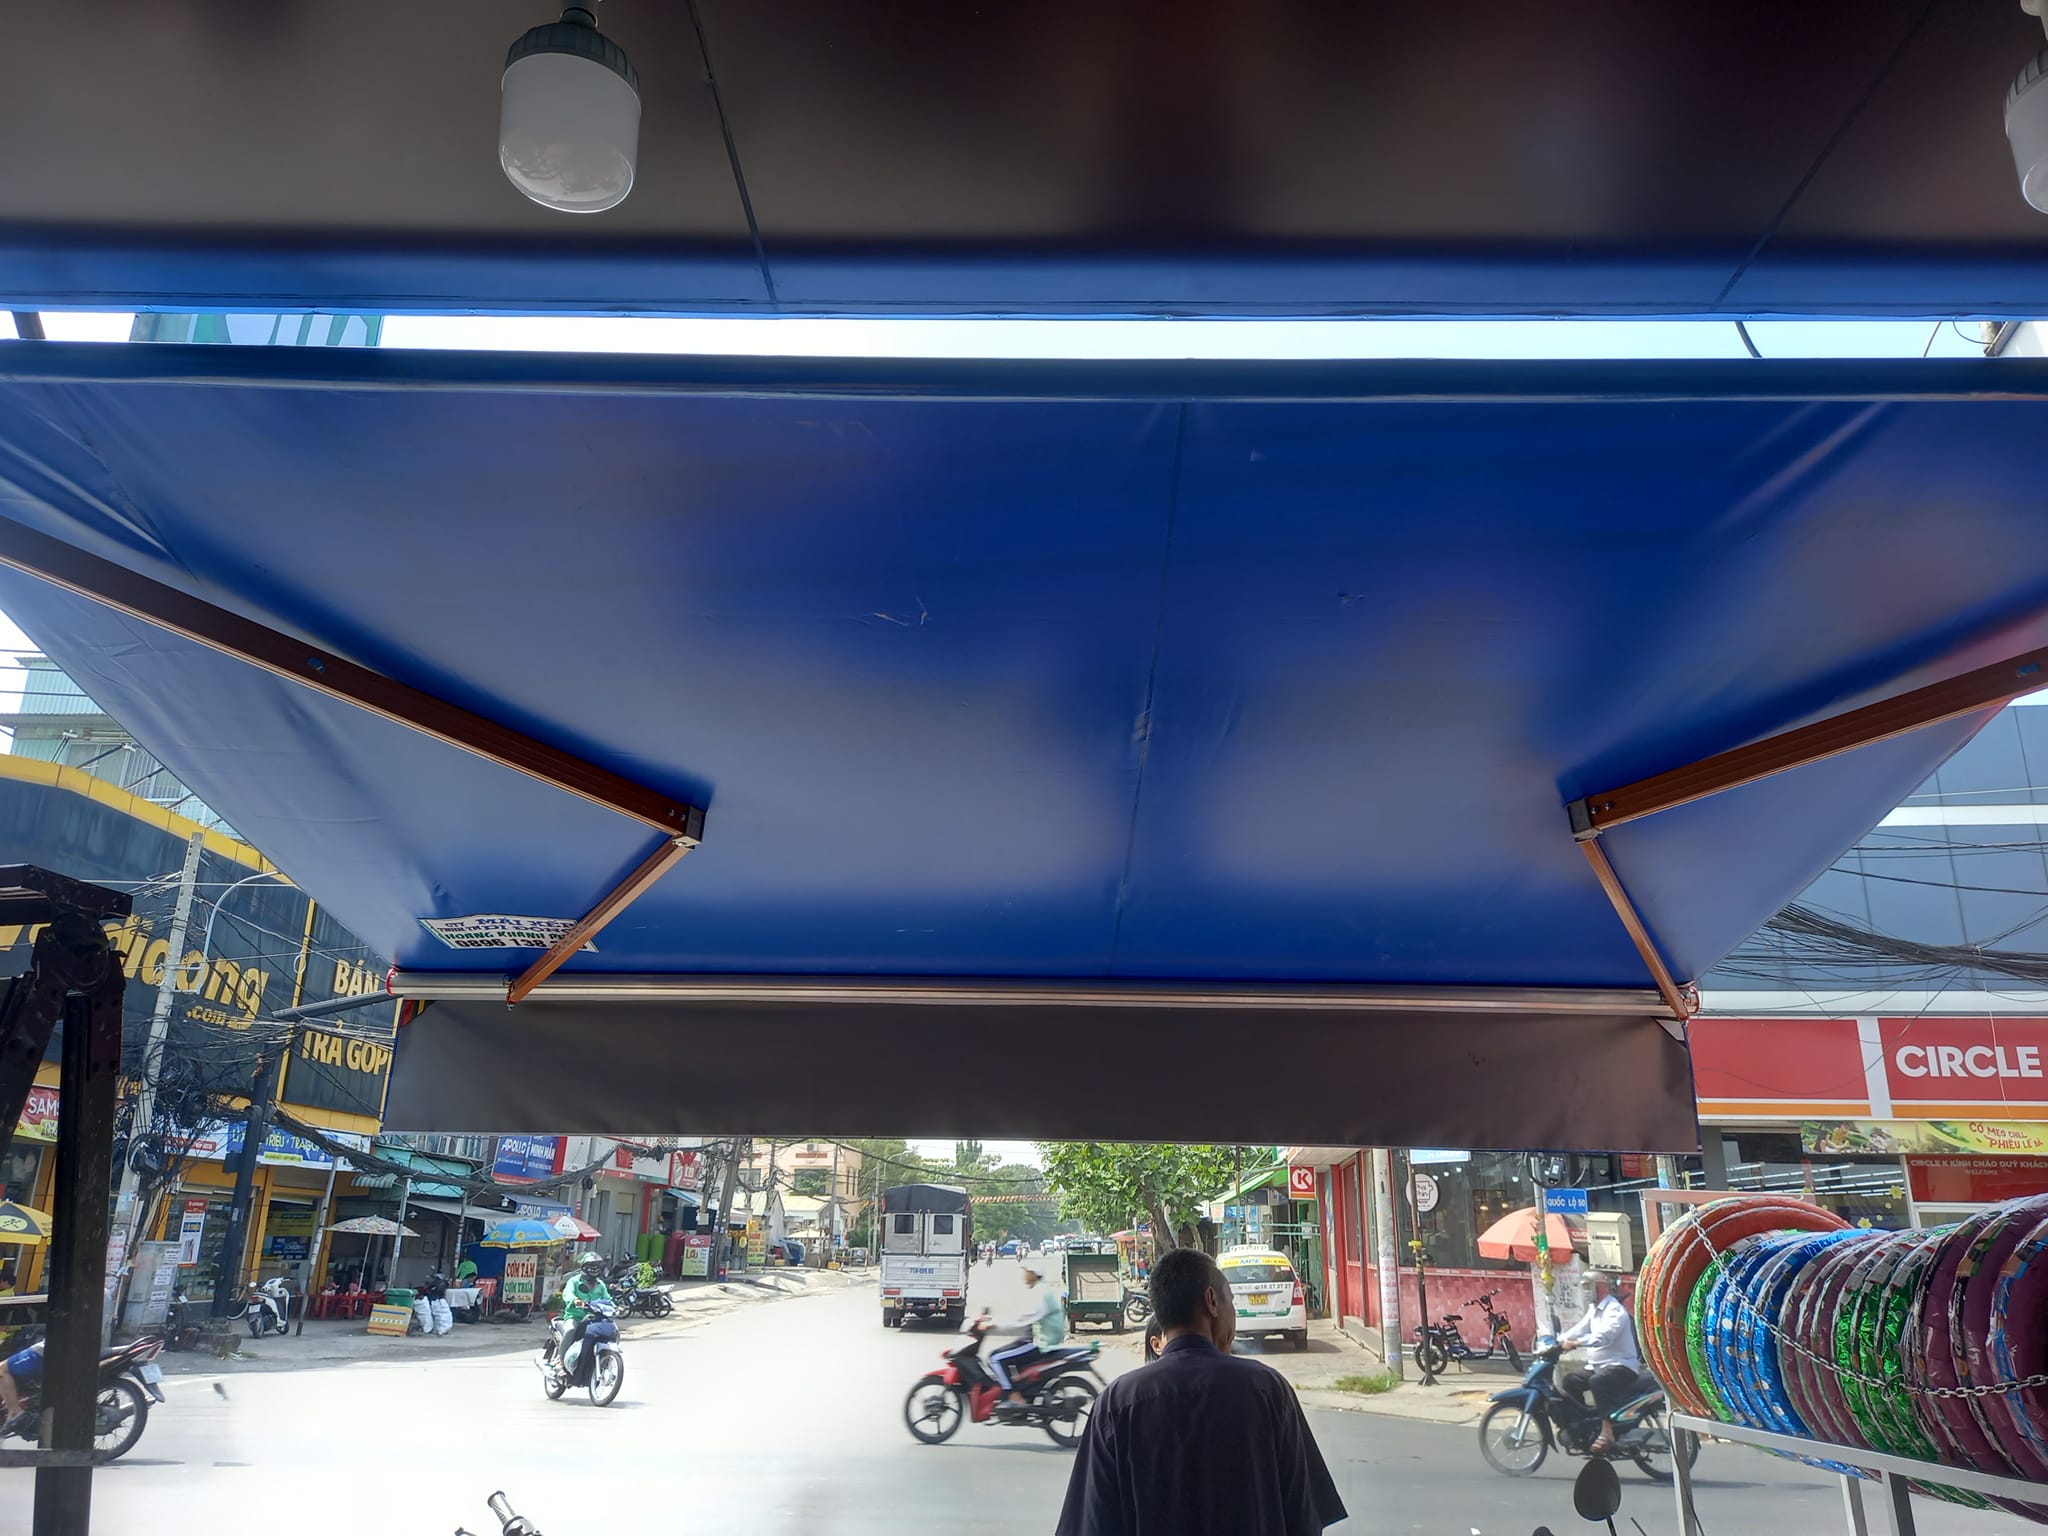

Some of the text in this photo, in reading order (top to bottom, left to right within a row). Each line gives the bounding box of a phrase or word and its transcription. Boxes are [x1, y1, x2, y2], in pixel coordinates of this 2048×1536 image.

[1895, 1045, 2043, 1079] CIRCLE
[1297, 1171, 1310, 1185] K
[1547, 1195, 1566, 1207] QUỐC
